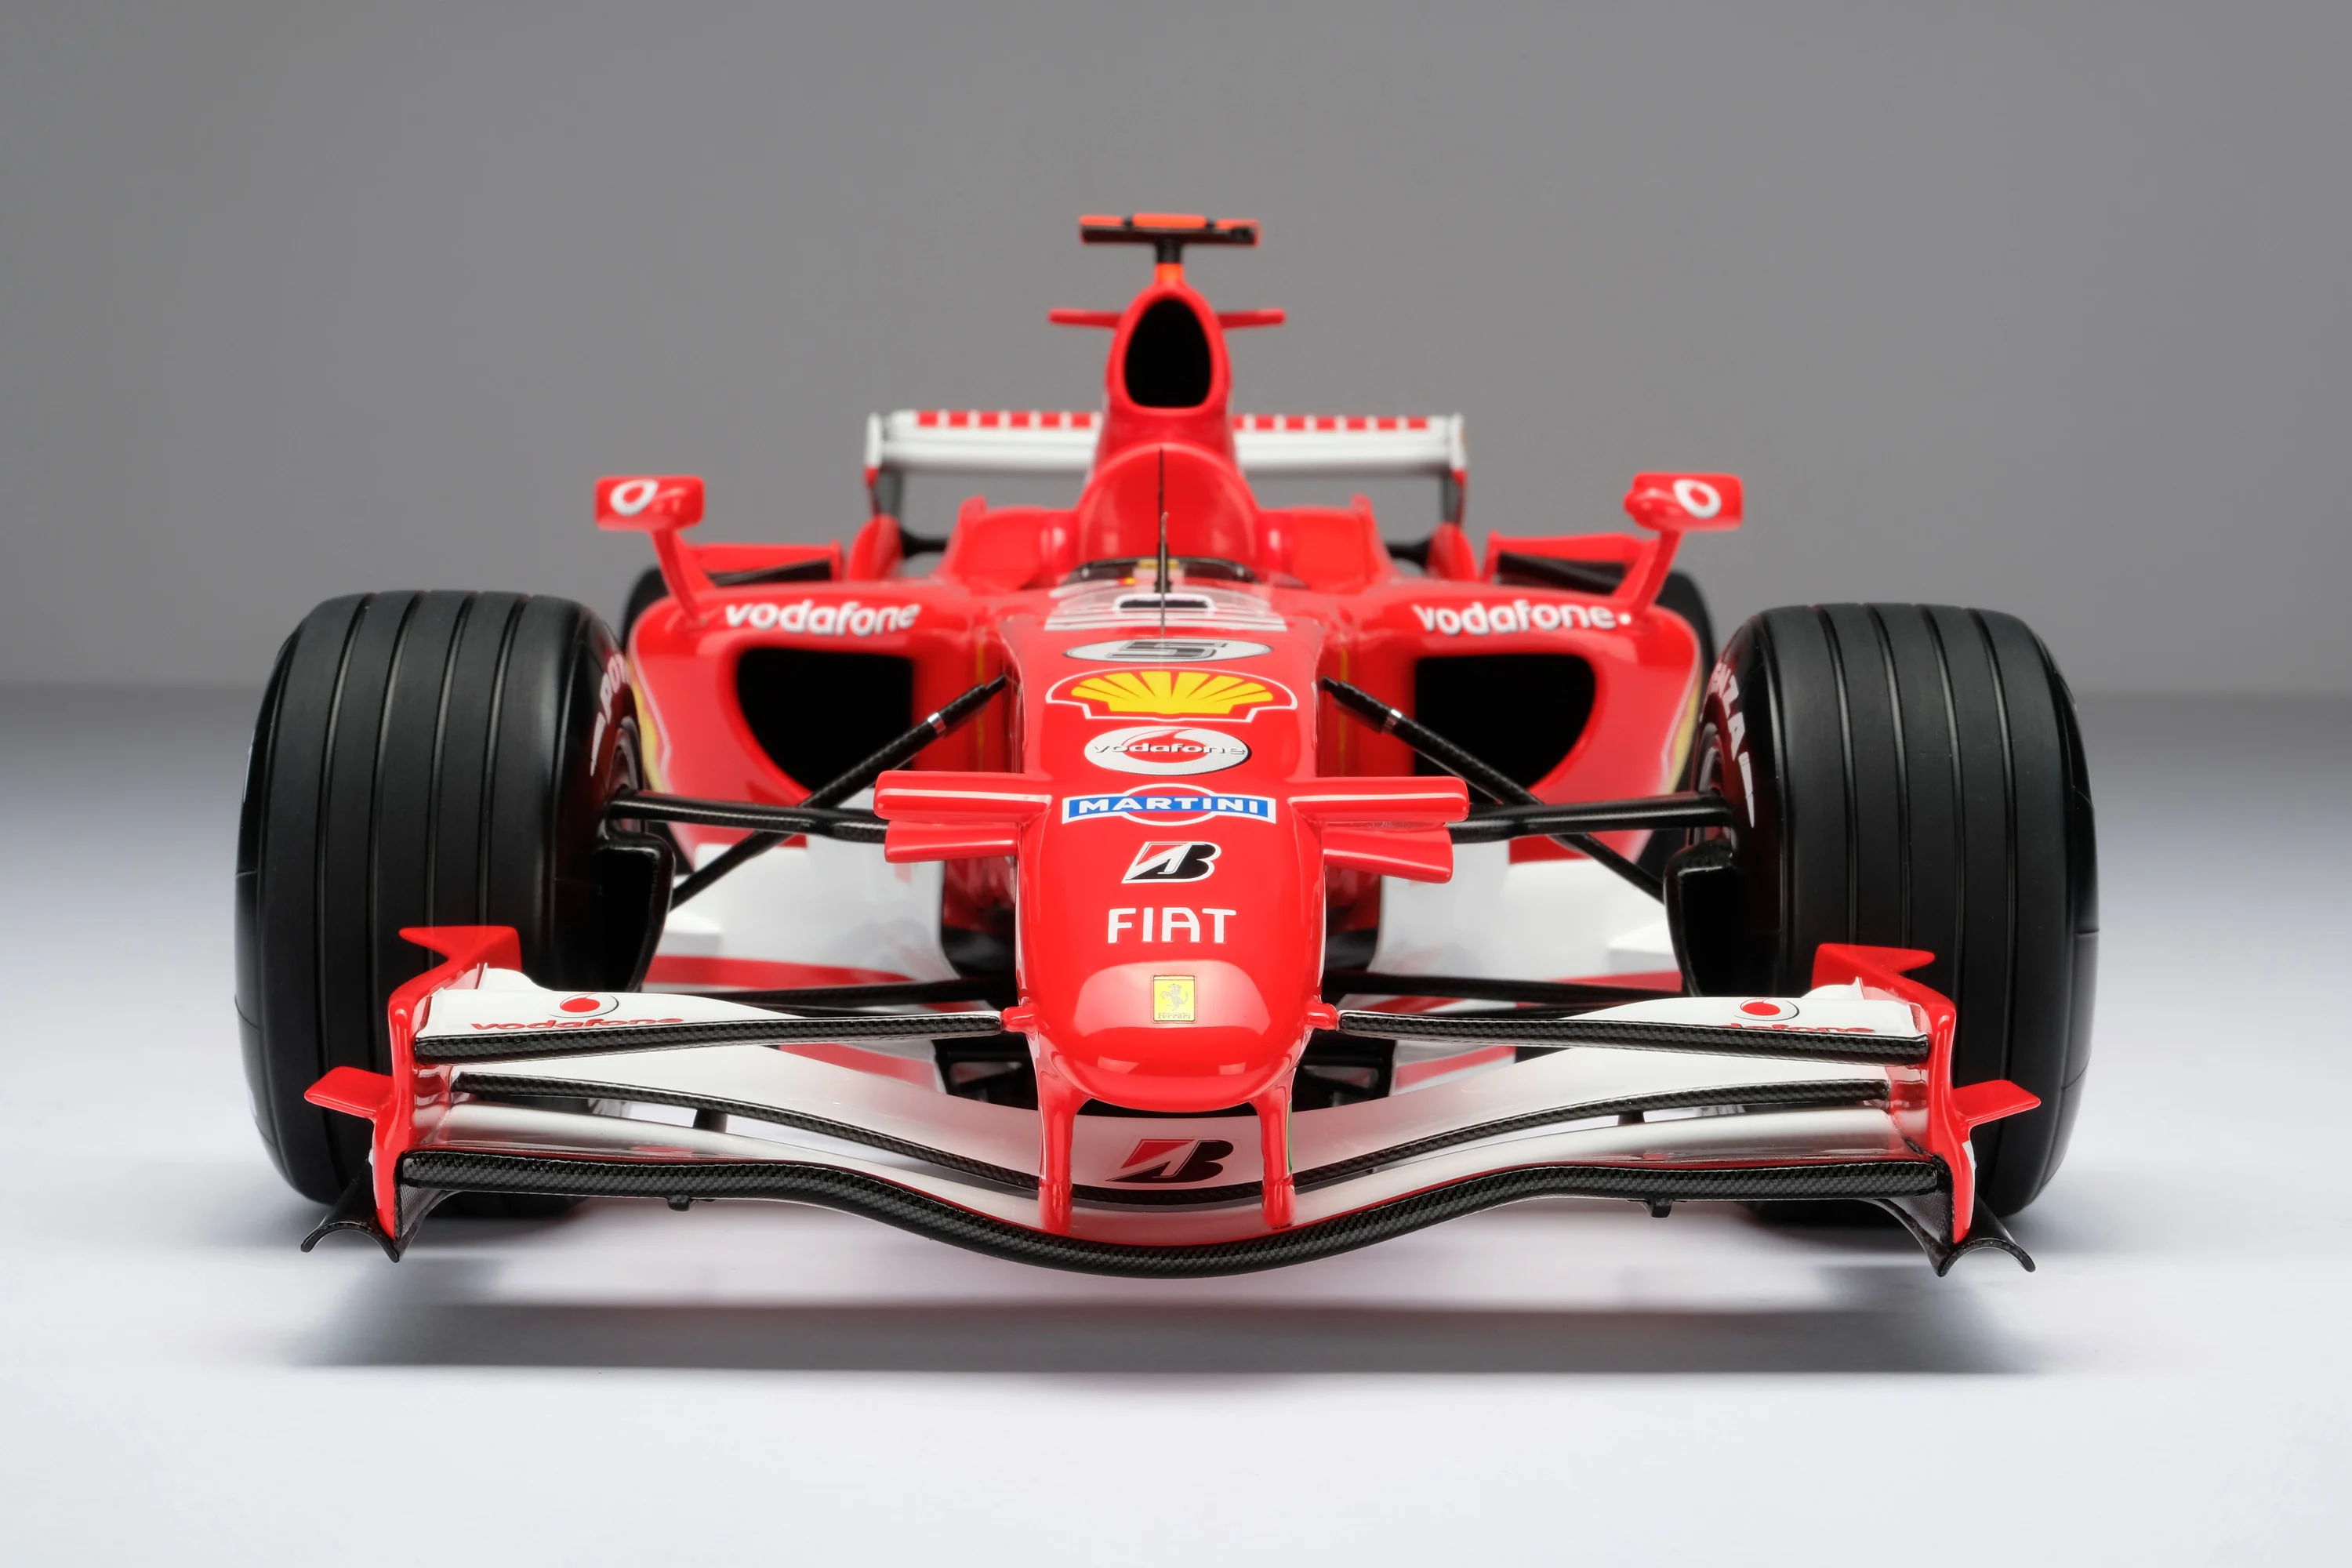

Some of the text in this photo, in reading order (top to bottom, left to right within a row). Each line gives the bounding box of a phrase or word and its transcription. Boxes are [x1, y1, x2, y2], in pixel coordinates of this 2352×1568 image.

[725, 598, 922, 637] vodafone
[1106, 640, 1229, 659] 5
[1094, 742, 1247, 756] vodafone
[1078, 797, 1259, 815] MARTINI
[1107, 907, 1237, 943] FIAT
[470, 1018, 684, 1031] vodafone
